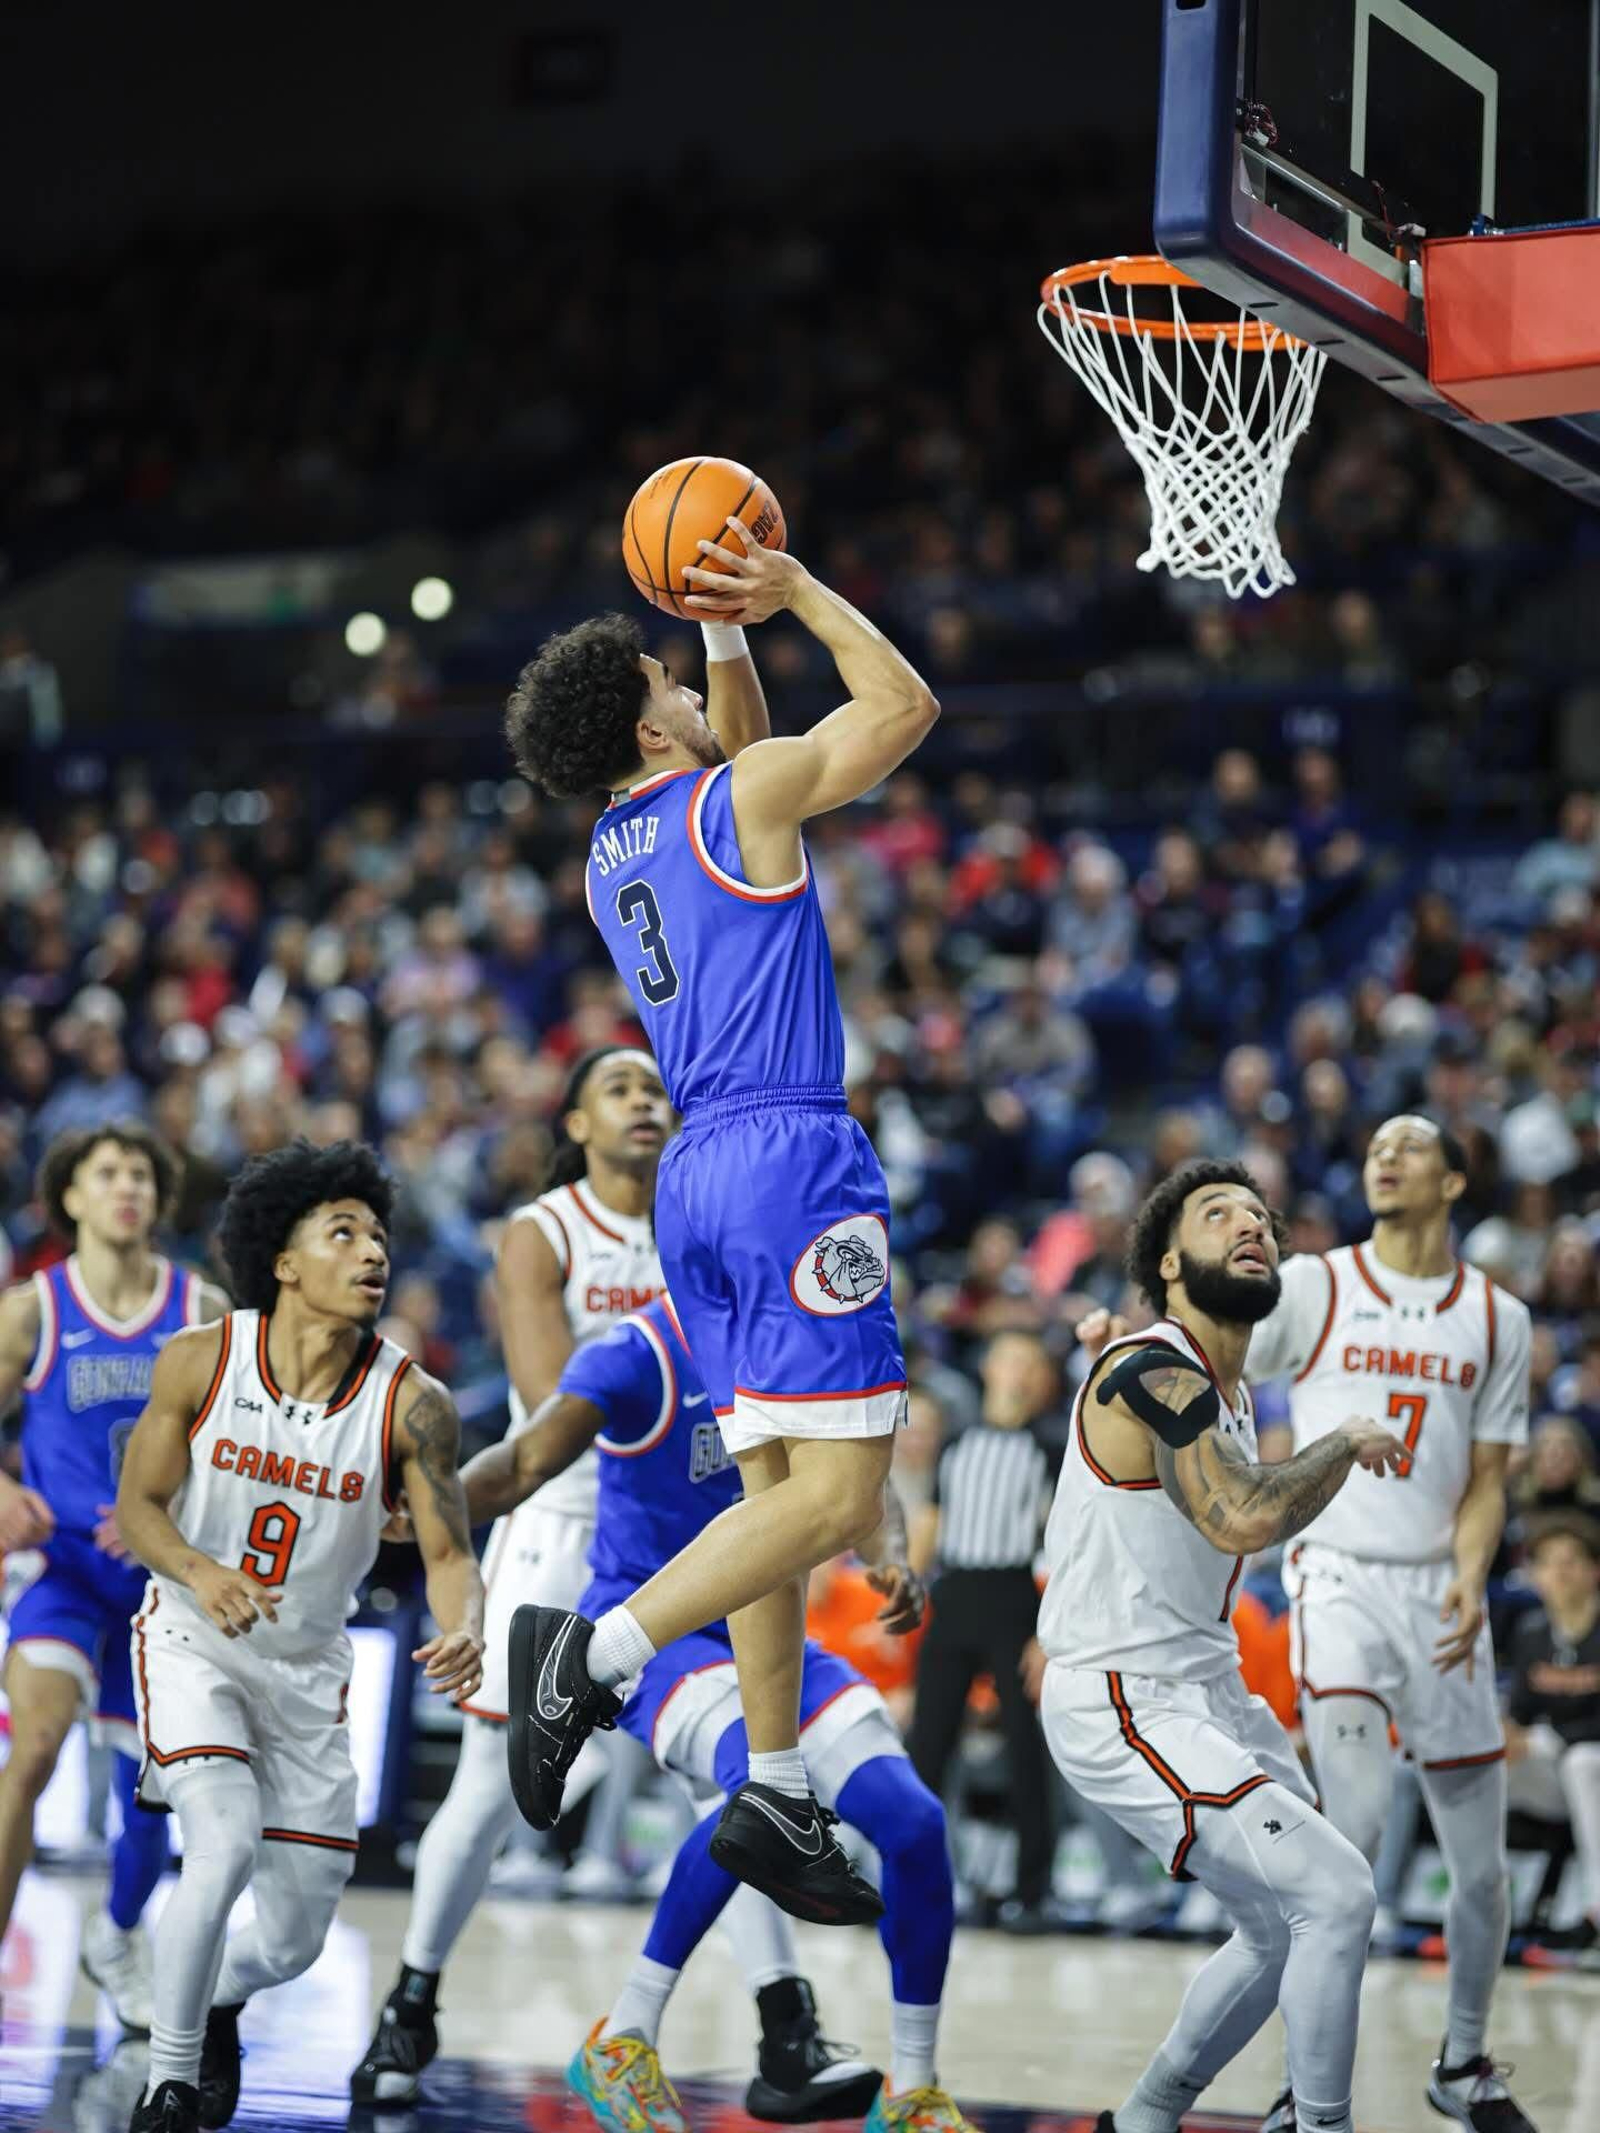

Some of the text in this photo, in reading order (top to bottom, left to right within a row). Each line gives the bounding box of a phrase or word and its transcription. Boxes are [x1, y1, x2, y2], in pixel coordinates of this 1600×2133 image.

[592, 816, 660, 877] SMITH
[616, 879, 680, 1006] 3
[586, 1286, 667, 1313] CAM
[1342, 1344, 1477, 1390] CAMELS
[1387, 1392, 1428, 1479] 7
[211, 1438, 365, 1503] CAMELS
[240, 1501, 302, 1588] 9
